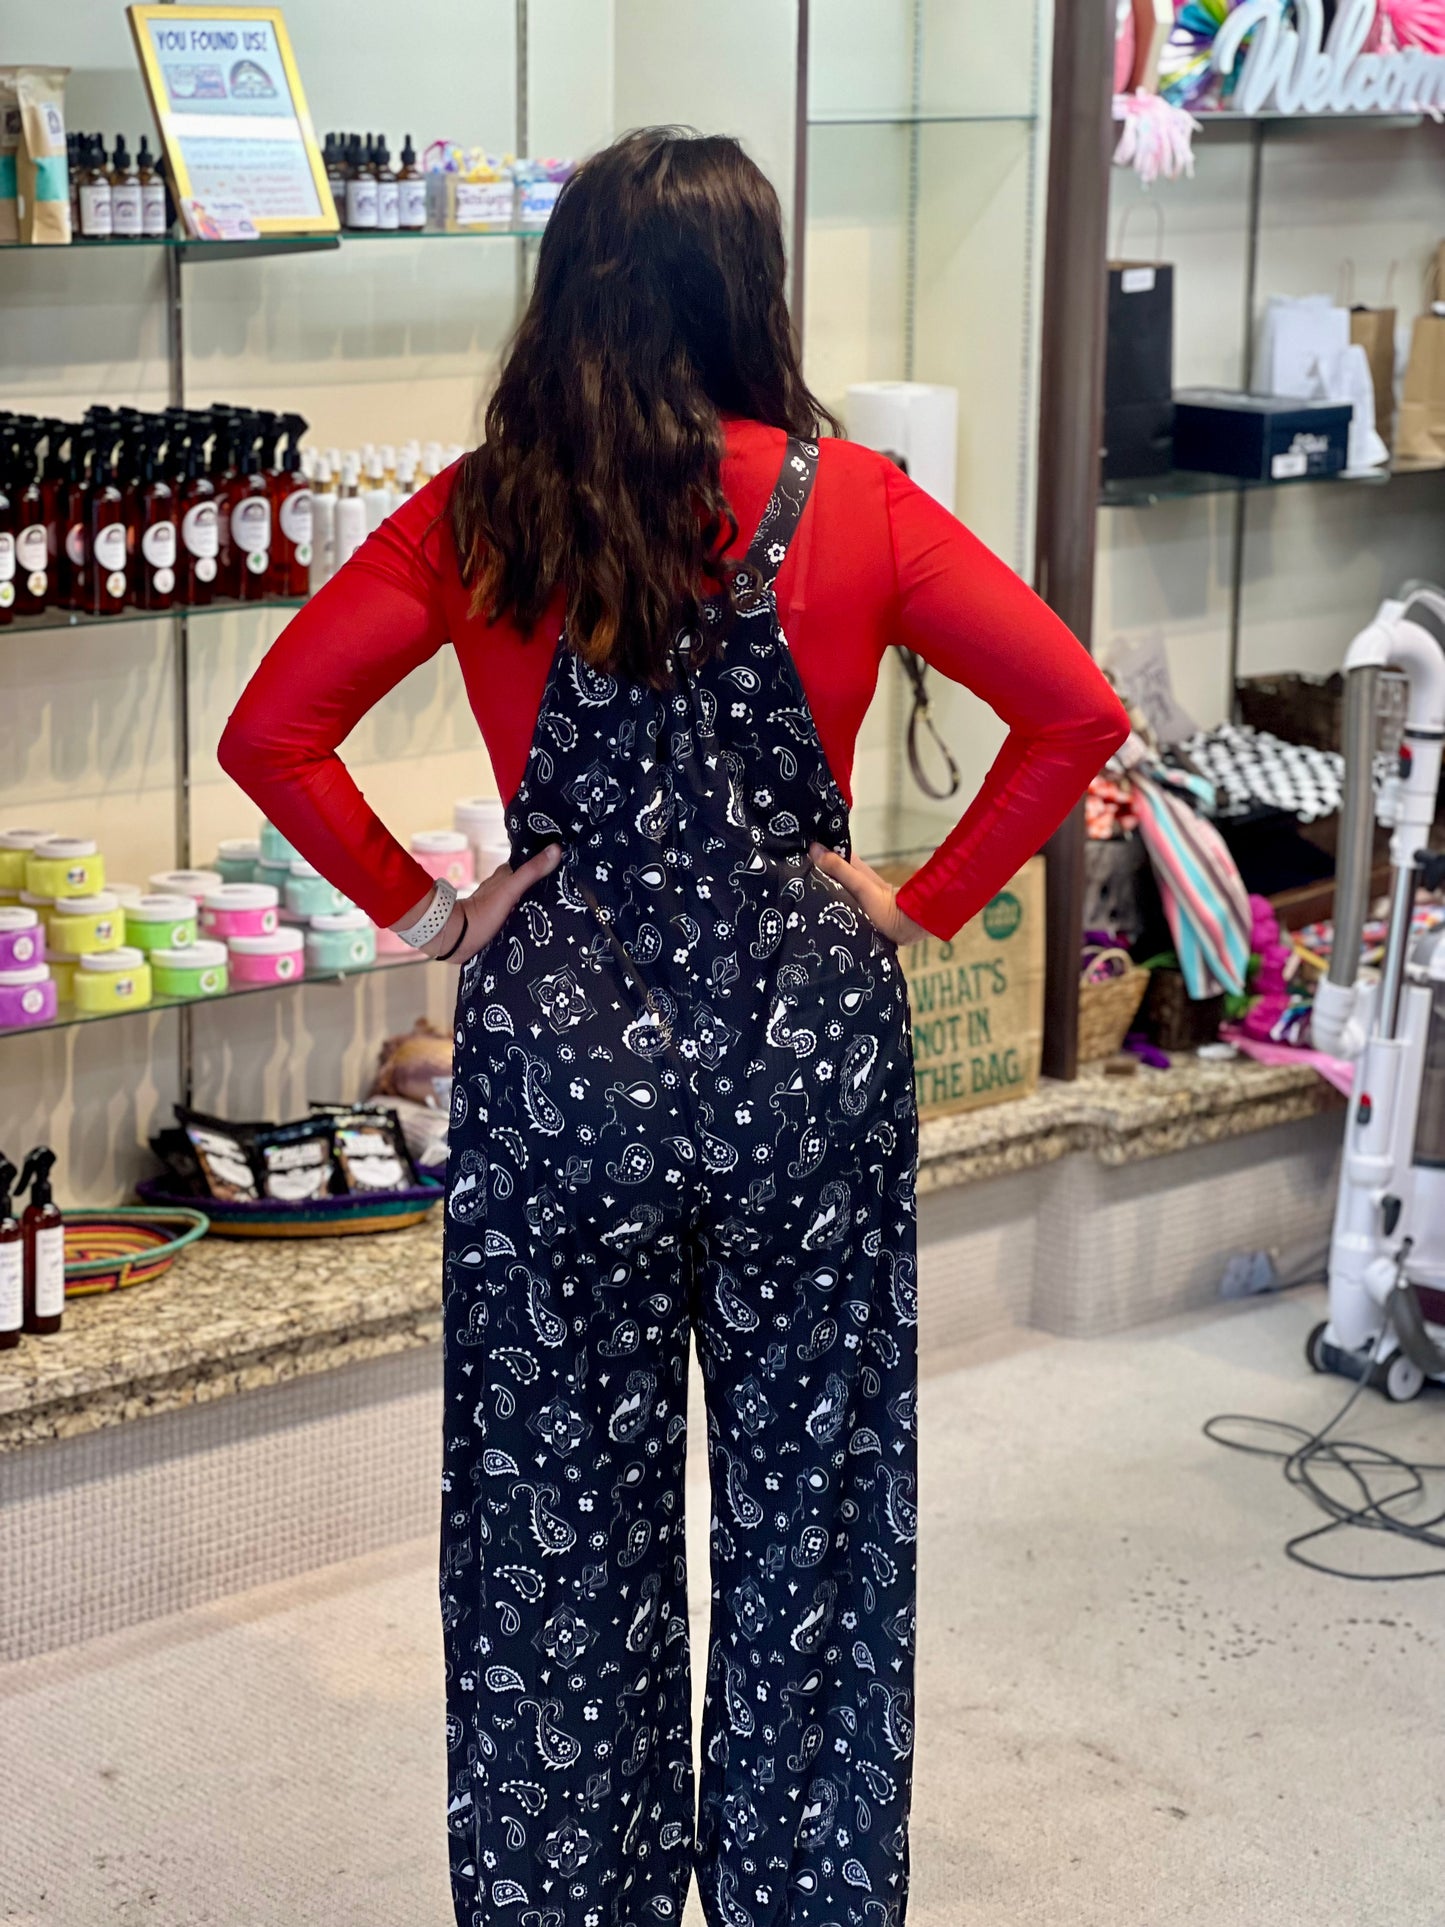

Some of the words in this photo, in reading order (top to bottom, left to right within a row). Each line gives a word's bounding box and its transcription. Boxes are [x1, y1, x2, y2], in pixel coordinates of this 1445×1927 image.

[156, 30, 186, 51] YOU
[191, 31, 239, 51] FOUND
[242, 31, 268, 52] US!
[911, 958, 1007, 1014] WHAT'S
[913, 1015, 961, 1060] NOT
[968, 1006, 992, 1047] IN
[915, 1061, 965, 1105] THE
